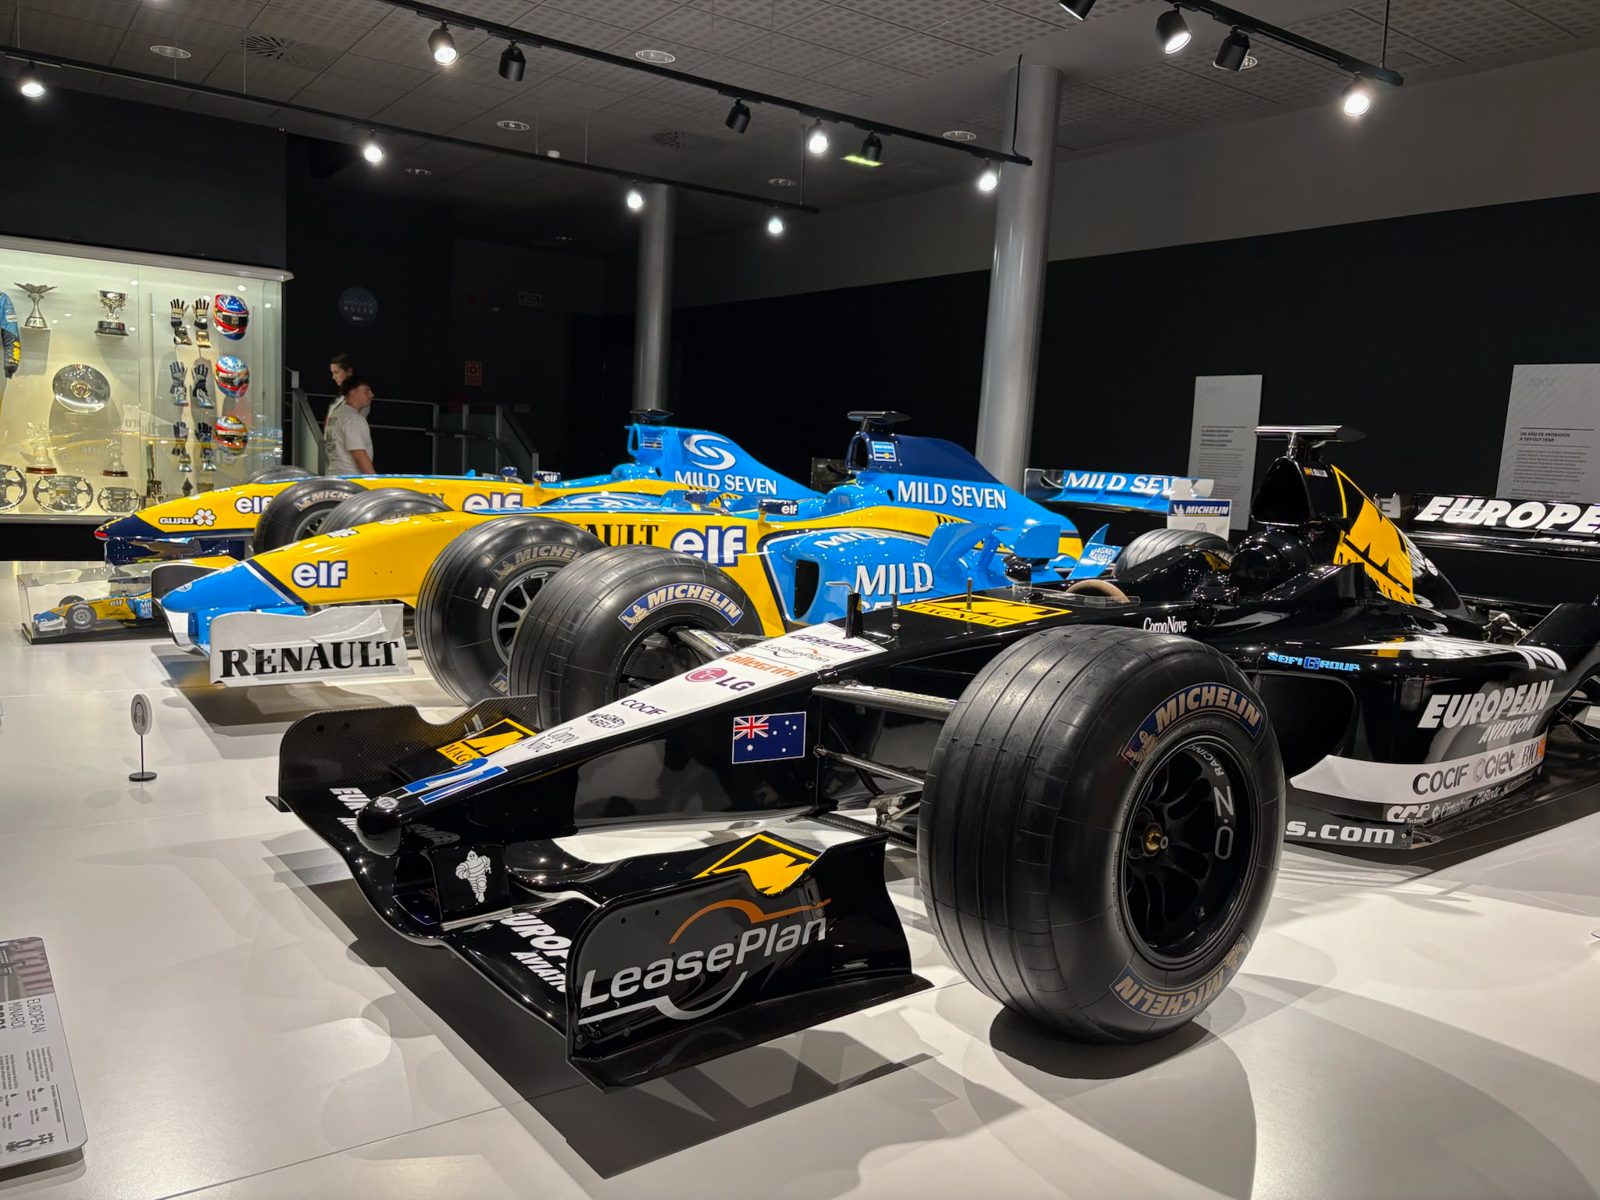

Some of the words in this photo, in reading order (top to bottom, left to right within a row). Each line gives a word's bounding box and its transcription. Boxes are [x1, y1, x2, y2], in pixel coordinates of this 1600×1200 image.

[675, 470, 721, 489] MILD
[724, 474, 777, 495] SEVEN
[897, 480, 948, 505] MILD
[951, 485, 1007, 510] SEVEN
[1065, 472, 1127, 491] MILD
[1129, 475, 1176, 495] SEV
[463, 492, 523, 512] elf
[781, 504, 798, 515] elf
[1185, 506, 1230, 514] MICHELIN
[159, 517, 197, 526] GURU
[586, 524, 659, 547] AULT
[514, 545, 584, 565] MICHEL
[671, 525, 747, 567] elf
[292, 560, 348, 588] elf
[854, 562, 934, 596] MILD
[646, 584, 742, 619] MICHELIN
[220, 641, 399, 678] RENAULT
[725, 655, 800, 678] allegrini
[716, 676, 755, 692] LG
[1155, 685, 1262, 733] MICHELIN
[1417, 679, 1554, 729] EUROPEAN
[1478, 714, 1539, 745] AVIATION
[443, 743, 474, 763] MAG
[1412, 763, 1470, 796] COCIF
[579, 918, 827, 1008] LeasePlan
[1114, 970, 1224, 1016] MICHELIN
[9, 1000, 26, 1031] MINARDI
[27, 997, 47, 1034] EUROPEAN
